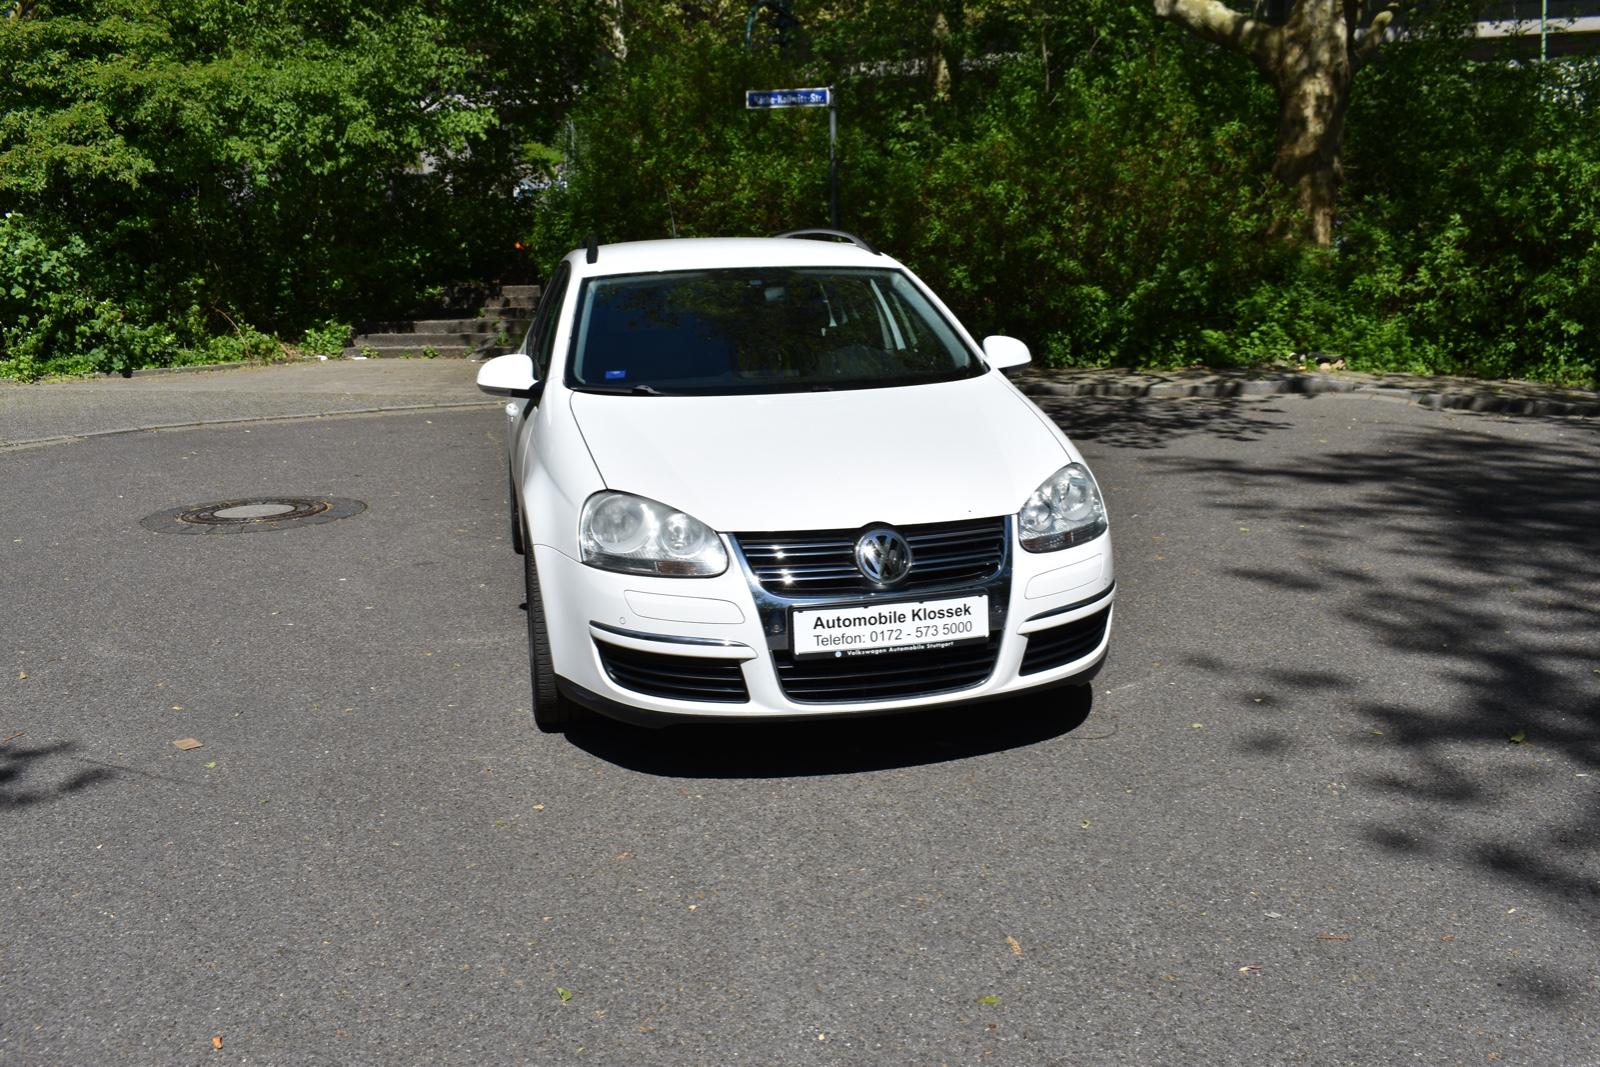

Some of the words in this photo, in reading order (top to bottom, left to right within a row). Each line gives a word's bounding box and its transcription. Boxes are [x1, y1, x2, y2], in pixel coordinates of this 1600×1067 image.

[813, 611, 906, 630] Automobile
[911, 604, 971, 622] Klossek
[813, 633, 866, 647] Telefon:
[870, 628, 903, 643] 0172
[915, 625, 939, 638] 573
[942, 620, 973, 635] 5000
[847, 648, 887, 656] Volkswagen
[889, 644, 924, 652] Automobile
[926, 641, 954, 649] Stuttgart
